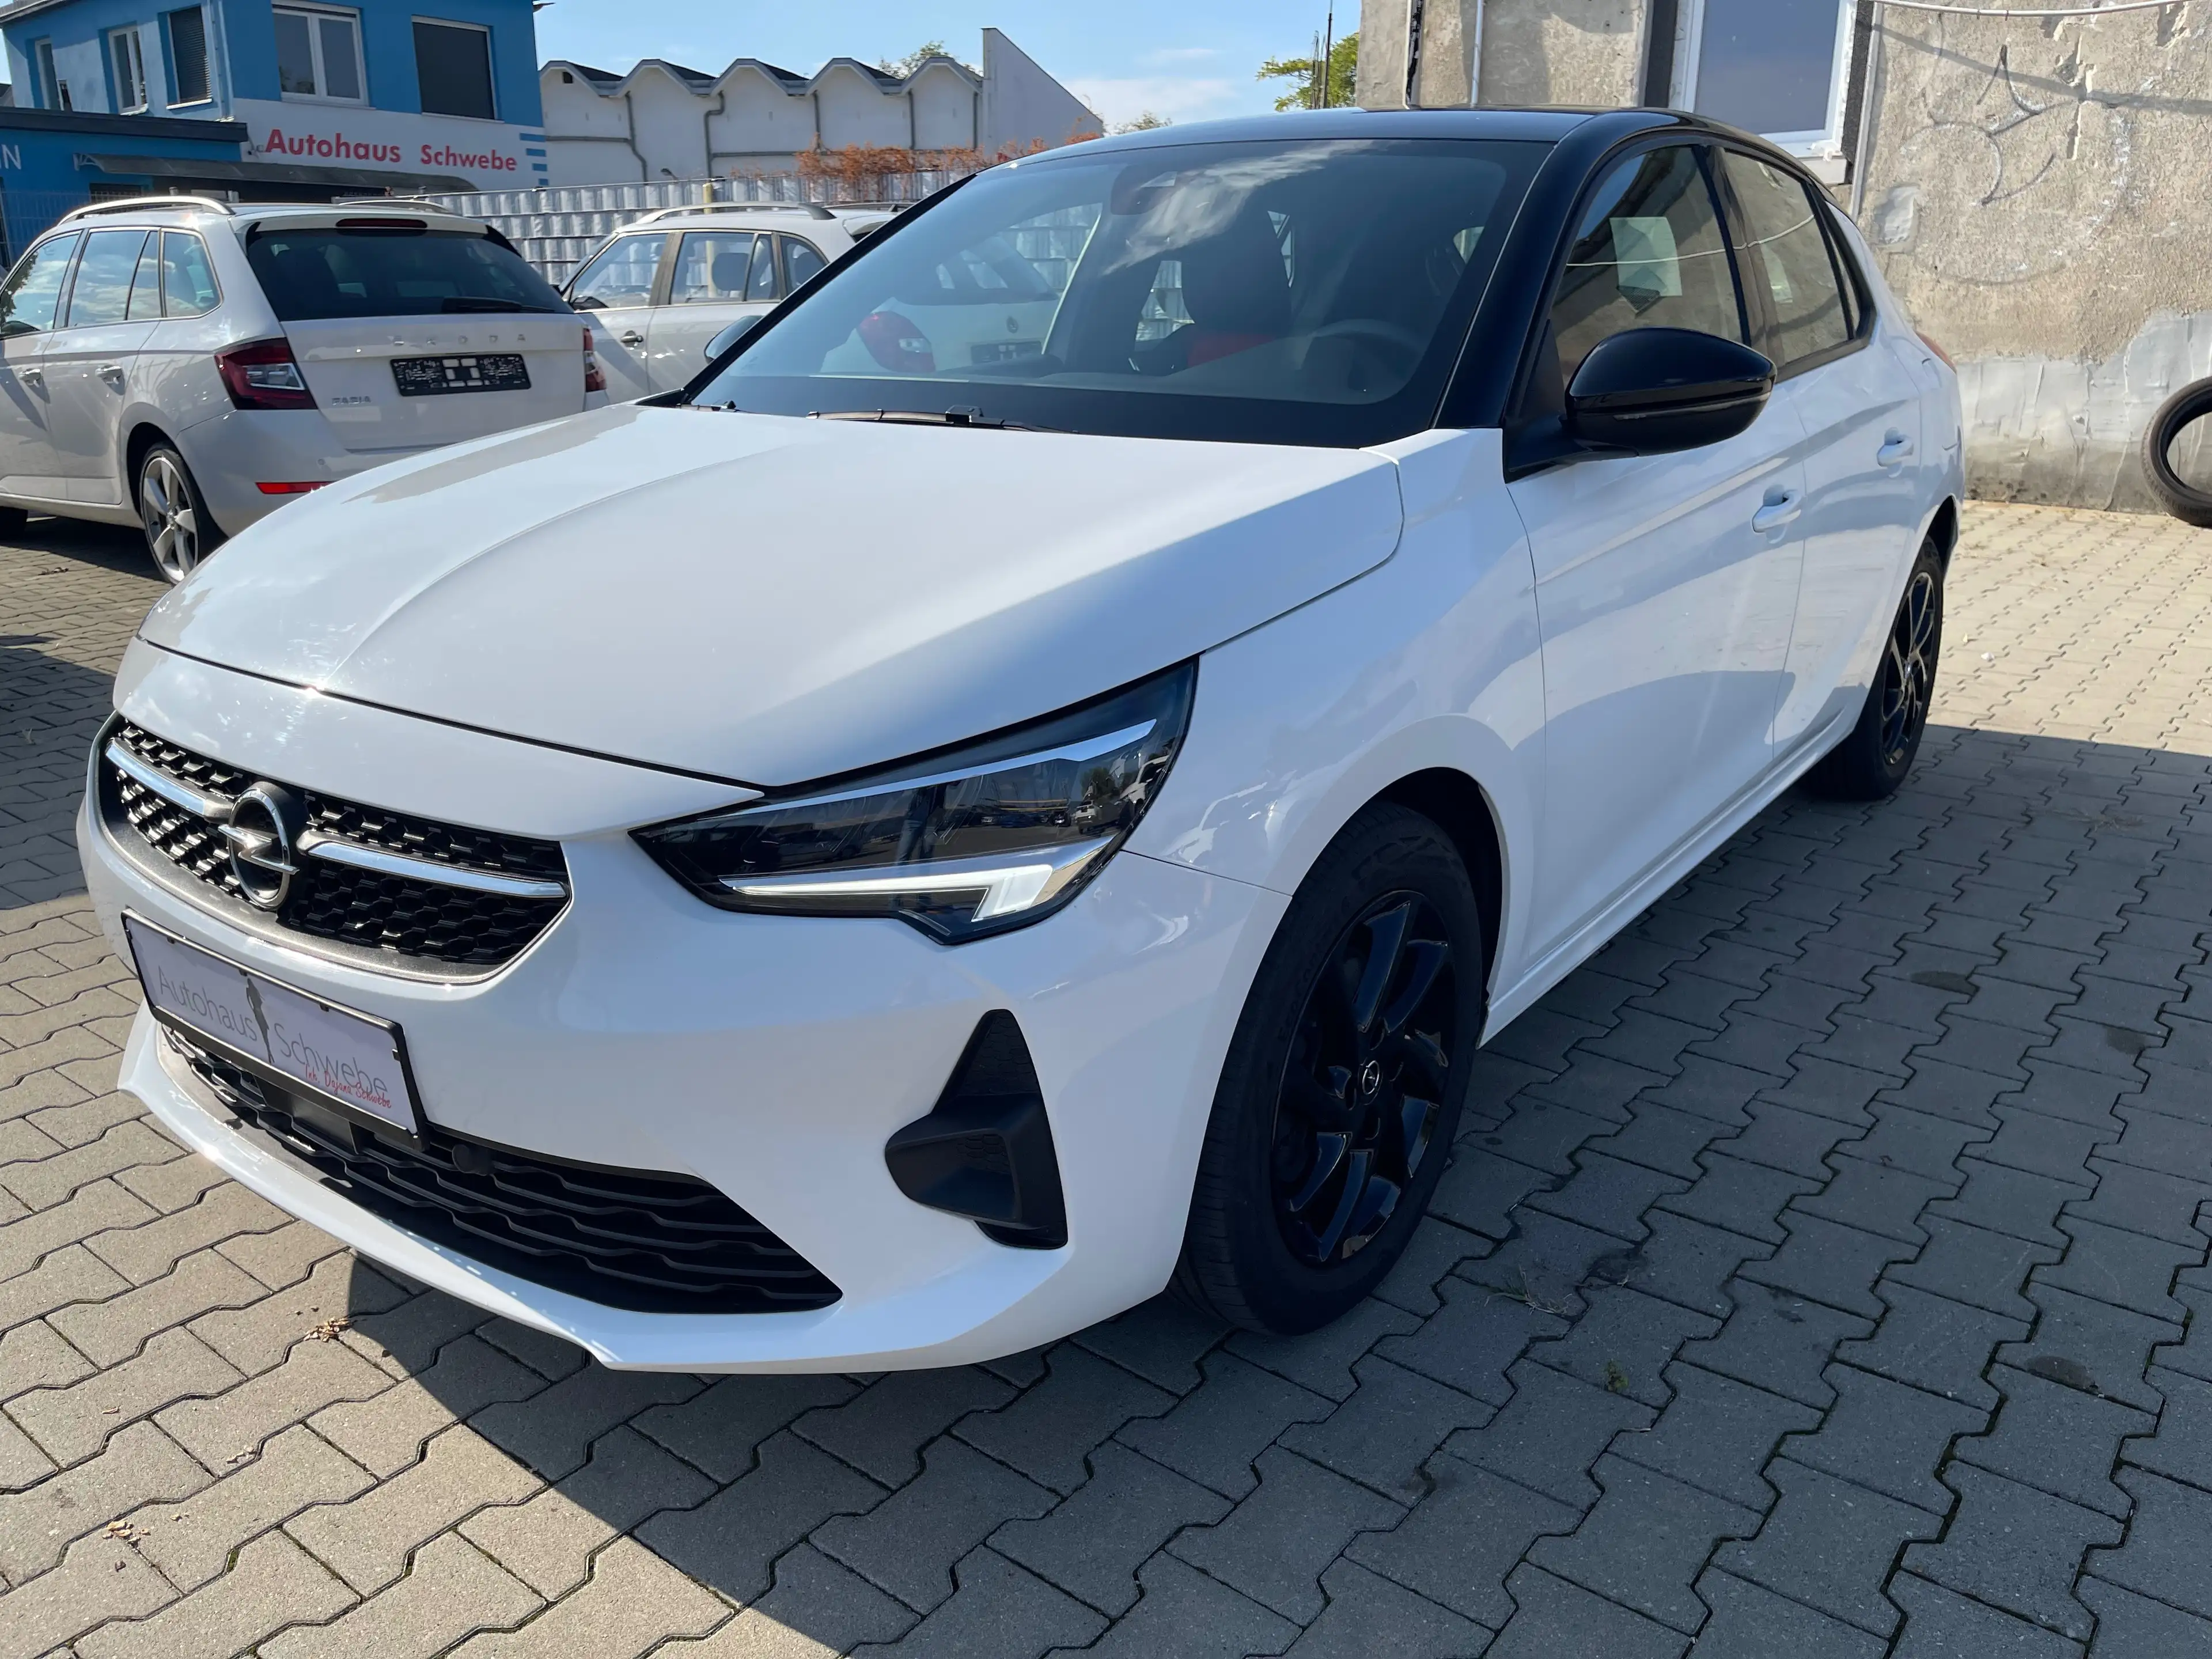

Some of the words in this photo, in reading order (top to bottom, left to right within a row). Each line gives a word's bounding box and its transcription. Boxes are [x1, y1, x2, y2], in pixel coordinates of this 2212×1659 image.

[0, 144, 21, 170] N
[265, 128, 400, 162] Autohaus
[420, 144, 517, 171] Schwebe
[158, 965, 257, 1041] Autohaus
[274, 1022, 388, 1097] Schwebe
[355, 1081, 392, 1109] Schwebe
